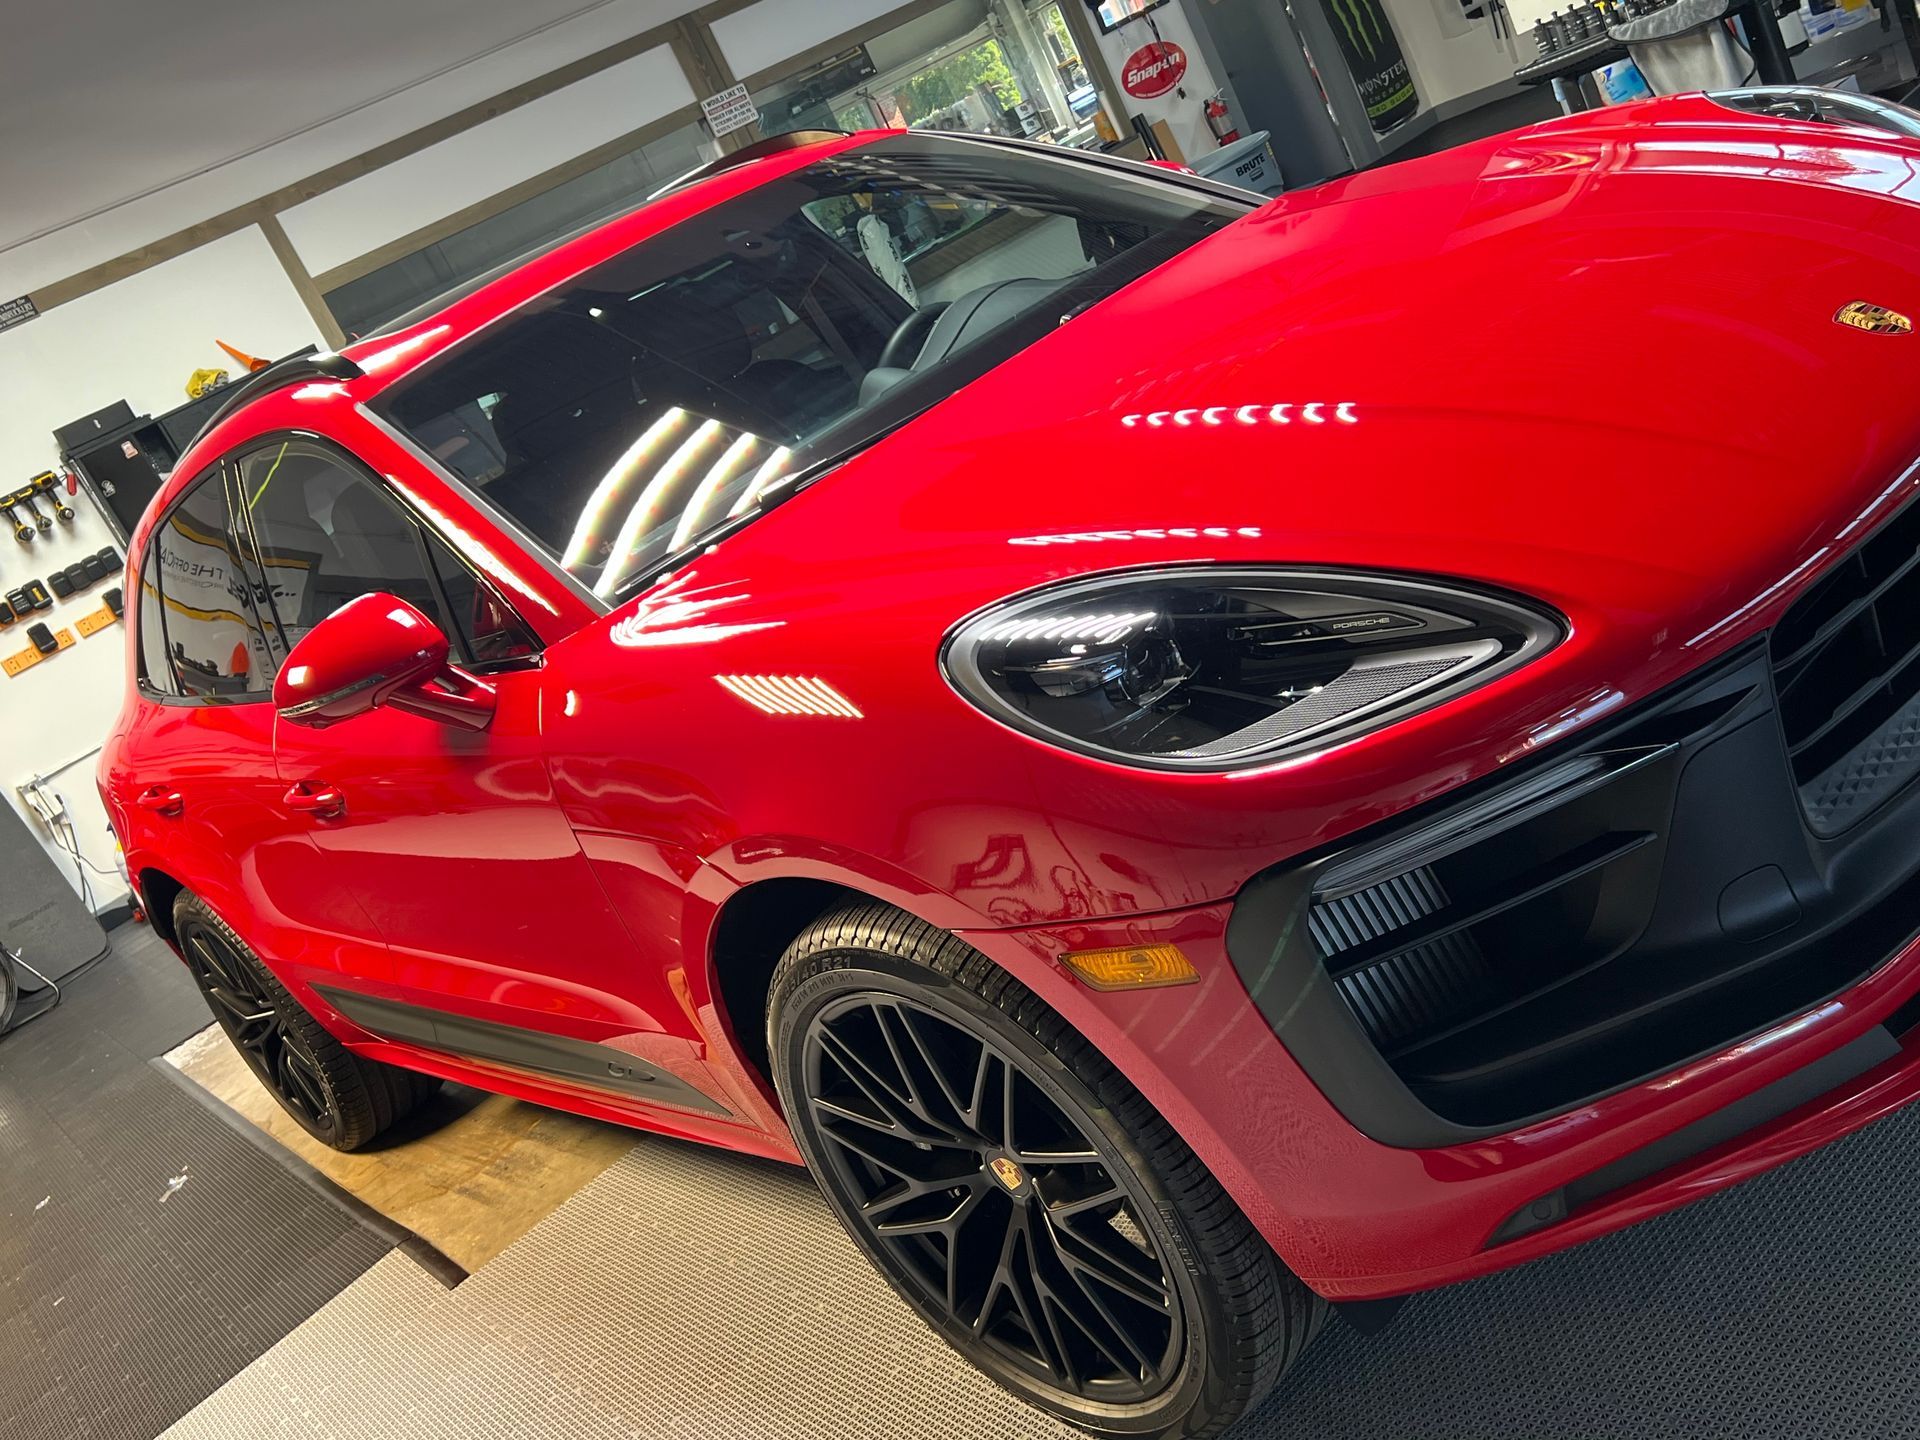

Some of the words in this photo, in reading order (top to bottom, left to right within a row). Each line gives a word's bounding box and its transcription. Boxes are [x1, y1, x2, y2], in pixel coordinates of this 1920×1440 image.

[1128, 52, 1180, 88] Snap-on
[1358, 59, 1407, 95] MONSTER
[707, 95, 725, 108] WOULD
[724, 90, 737, 100] LIKE
[736, 86, 745, 94] TO
[1235, 152, 1265, 177] BRUTE
[1332, 616, 1390, 629] PORSCHE
[821, 956, 851, 972] R21
